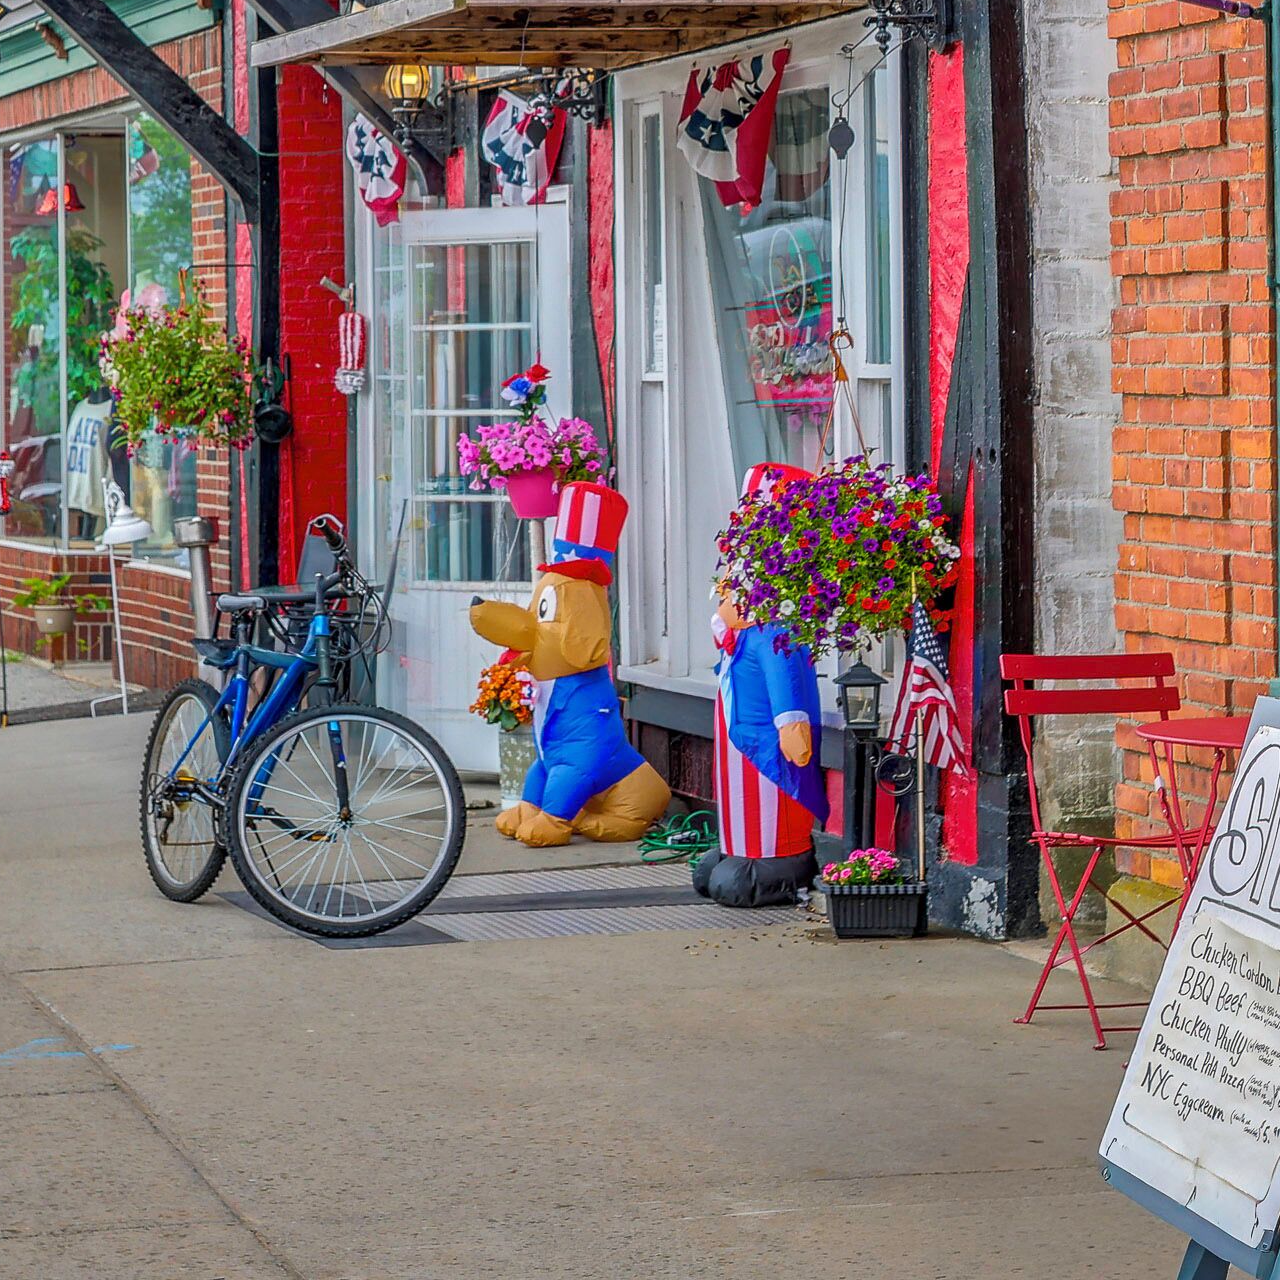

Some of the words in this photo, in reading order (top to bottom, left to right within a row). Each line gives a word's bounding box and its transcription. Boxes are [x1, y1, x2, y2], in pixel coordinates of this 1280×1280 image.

[1190, 926, 1238, 975] Chicken
[1239, 951, 1274, 994] Cordon
[1178, 966, 1215, 1006] BBQ
[1215, 982, 1248, 1017] Beef
[1152, 1033, 1199, 1072] Personal
[1160, 1000, 1212, 1043] Chicken
[1214, 1023, 1248, 1068] Philly
[1140, 1061, 1174, 1101] NYC
[1173, 1081, 1225, 1122] Eggcream
